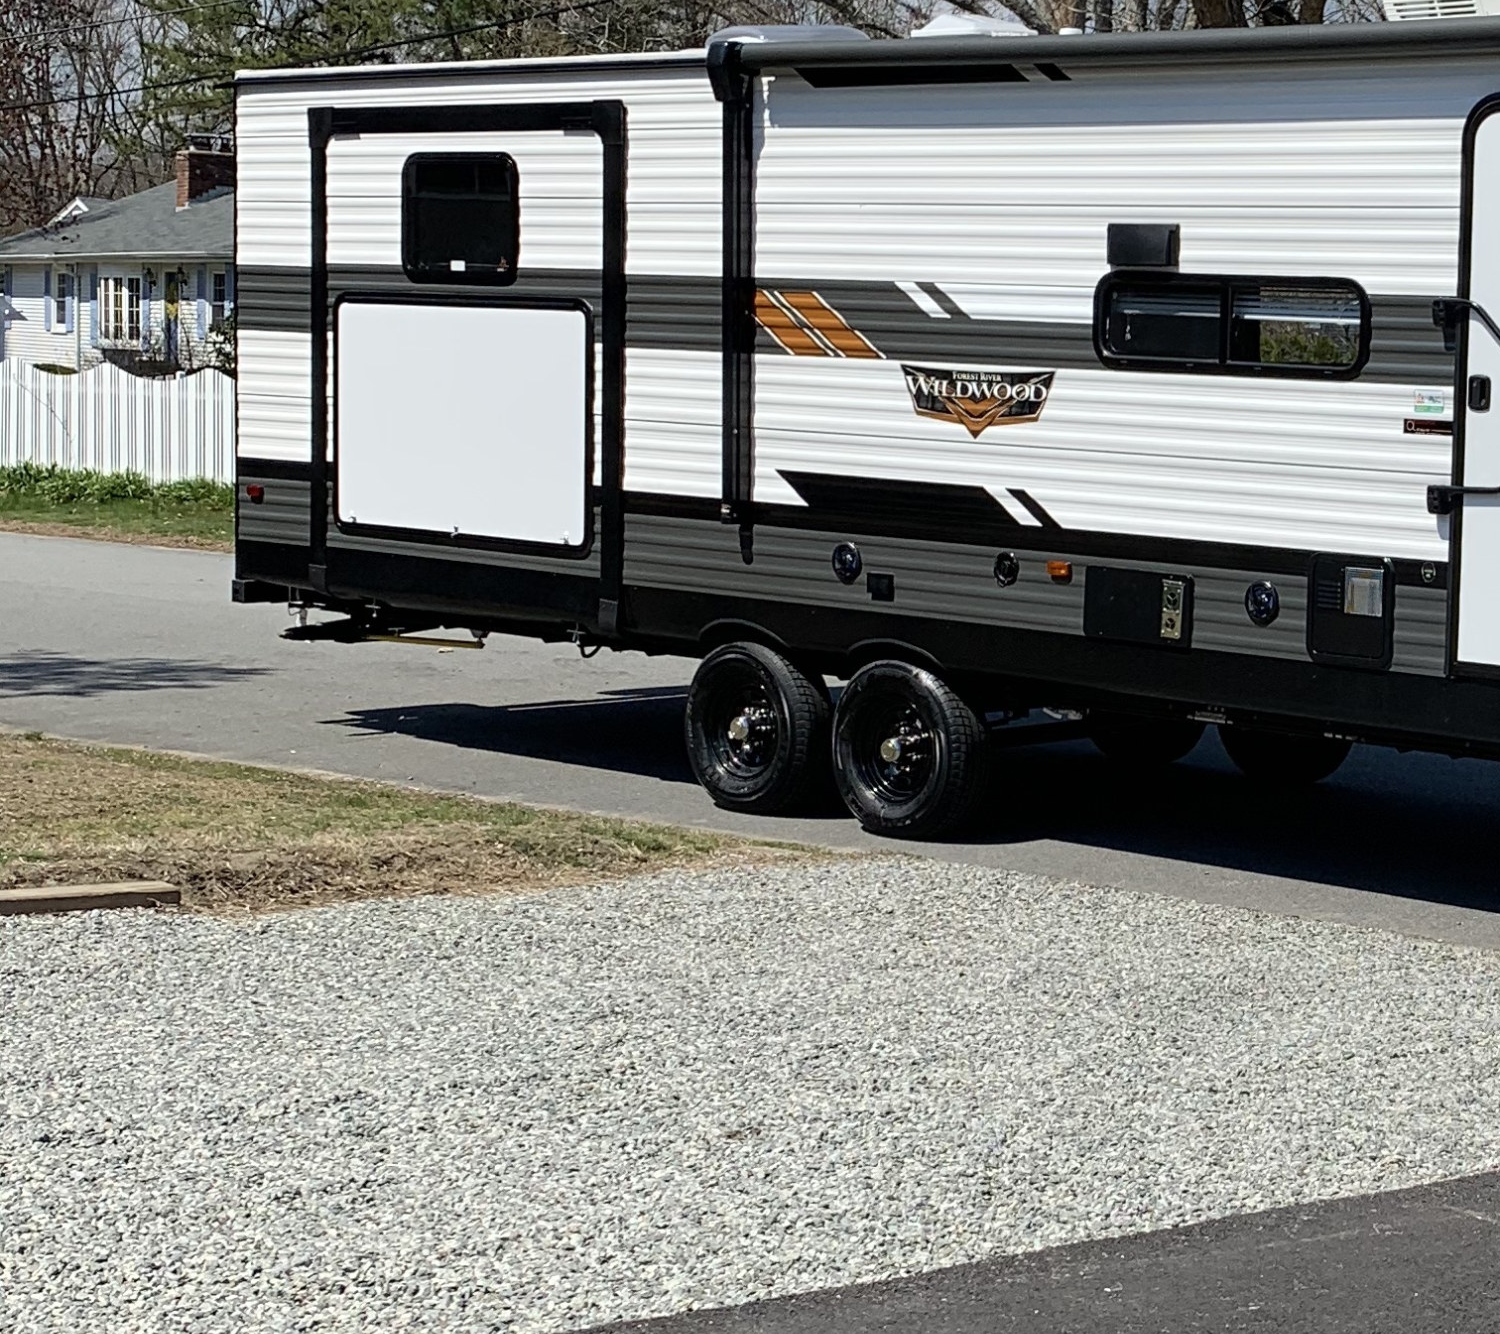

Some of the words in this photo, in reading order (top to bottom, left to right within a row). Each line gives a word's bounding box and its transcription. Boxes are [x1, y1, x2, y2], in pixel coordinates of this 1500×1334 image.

[952, 371, 979, 381] FOREST
[980, 372, 1002, 382] RIVER
[906, 375, 1047, 402] WILDWOOD
